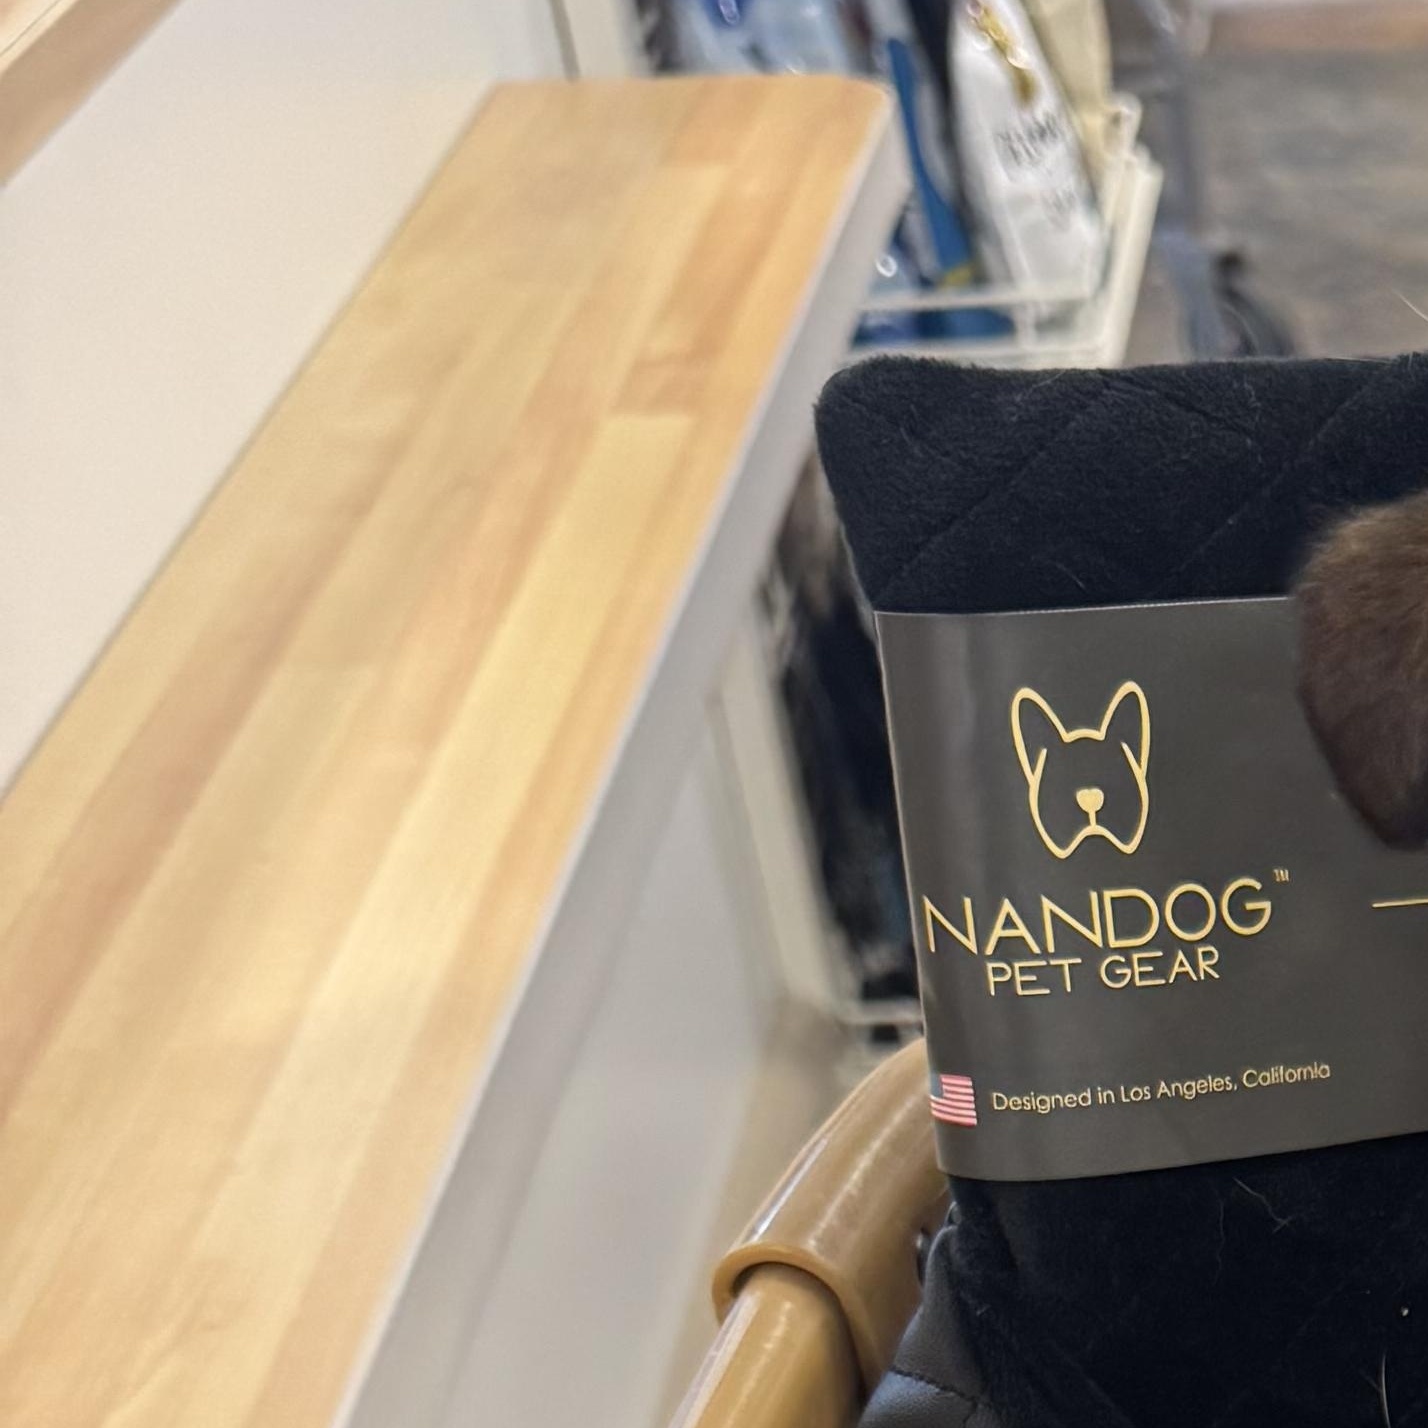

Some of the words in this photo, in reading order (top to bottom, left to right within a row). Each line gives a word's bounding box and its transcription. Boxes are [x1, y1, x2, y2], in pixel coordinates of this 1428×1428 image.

[985, 957, 1083, 997] PET
[1099, 945, 1221, 989] GEAR
[991, 1086, 1092, 1114] Designed
[1097, 1086, 1116, 1106] in
[1120, 1085, 1152, 1104] Los
[1156, 1074, 1238, 1100] Angeles,
[1241, 1062, 1331, 1089] California
